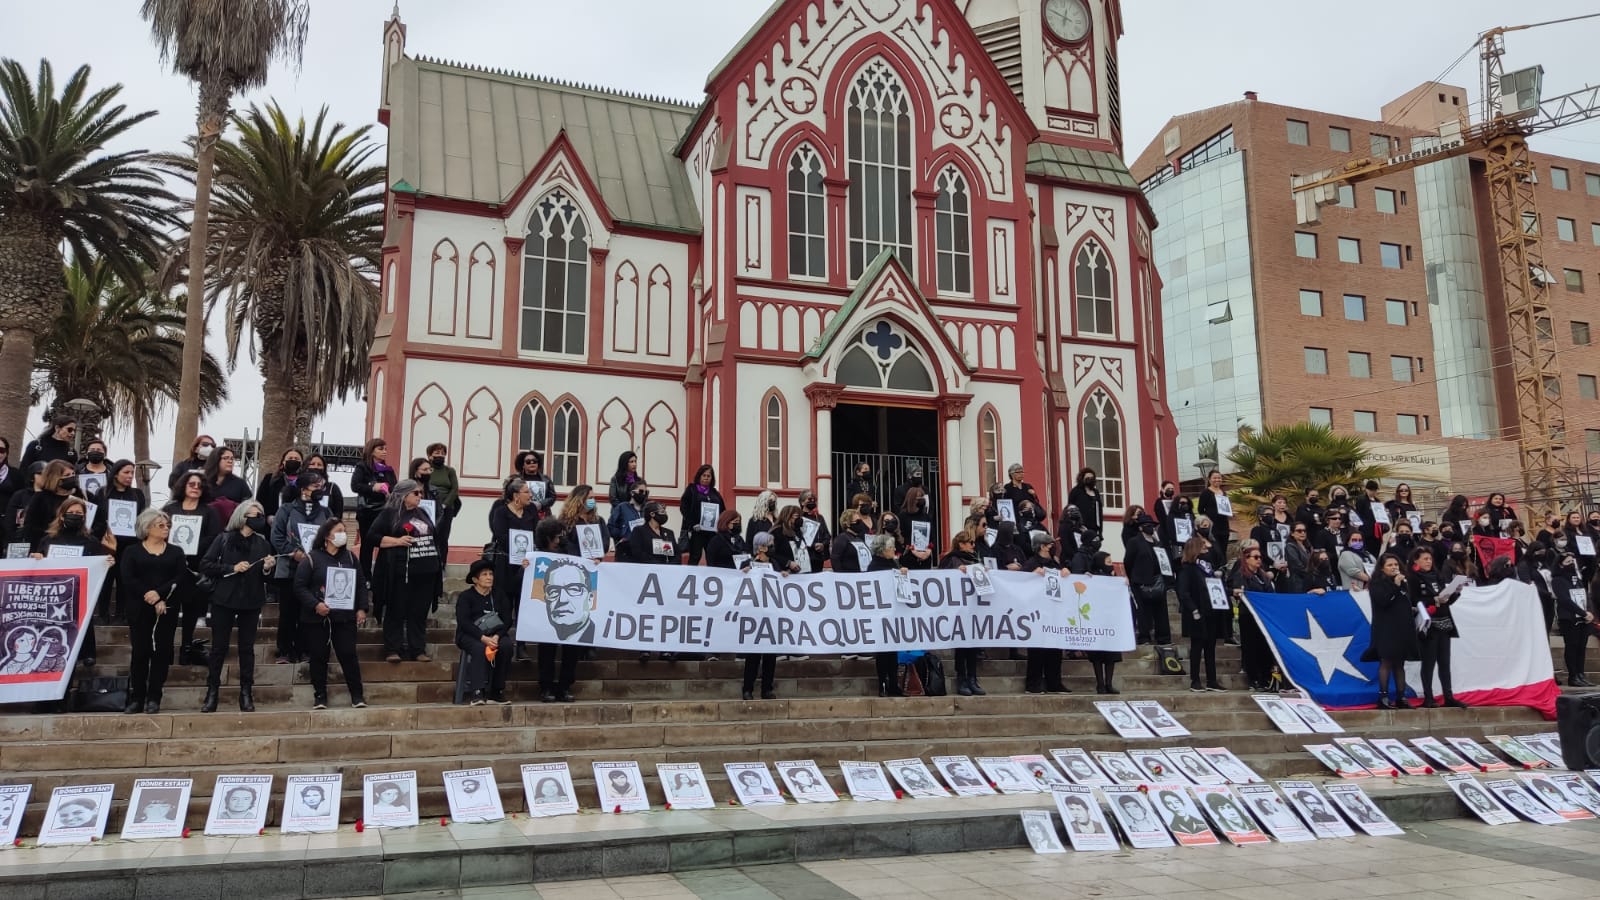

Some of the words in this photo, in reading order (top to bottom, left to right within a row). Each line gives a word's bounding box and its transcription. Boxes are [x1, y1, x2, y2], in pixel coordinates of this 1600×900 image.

[8, 583, 66, 596] LIBERTAD
[636, 573, 665, 606] A
[676, 574, 724, 607] 49
[734, 573, 826, 612] AÑOS
[835, 580, 892, 610] DEL
[660, 615, 714, 647] PIE!
[818, 618, 876, 647] QUE
[881, 614, 966, 645] NUNCA
[1042, 624, 1079, 635] MUJERES
[1081, 627, 1093, 635] DE
[1094, 628, 1115, 636] LUTO
